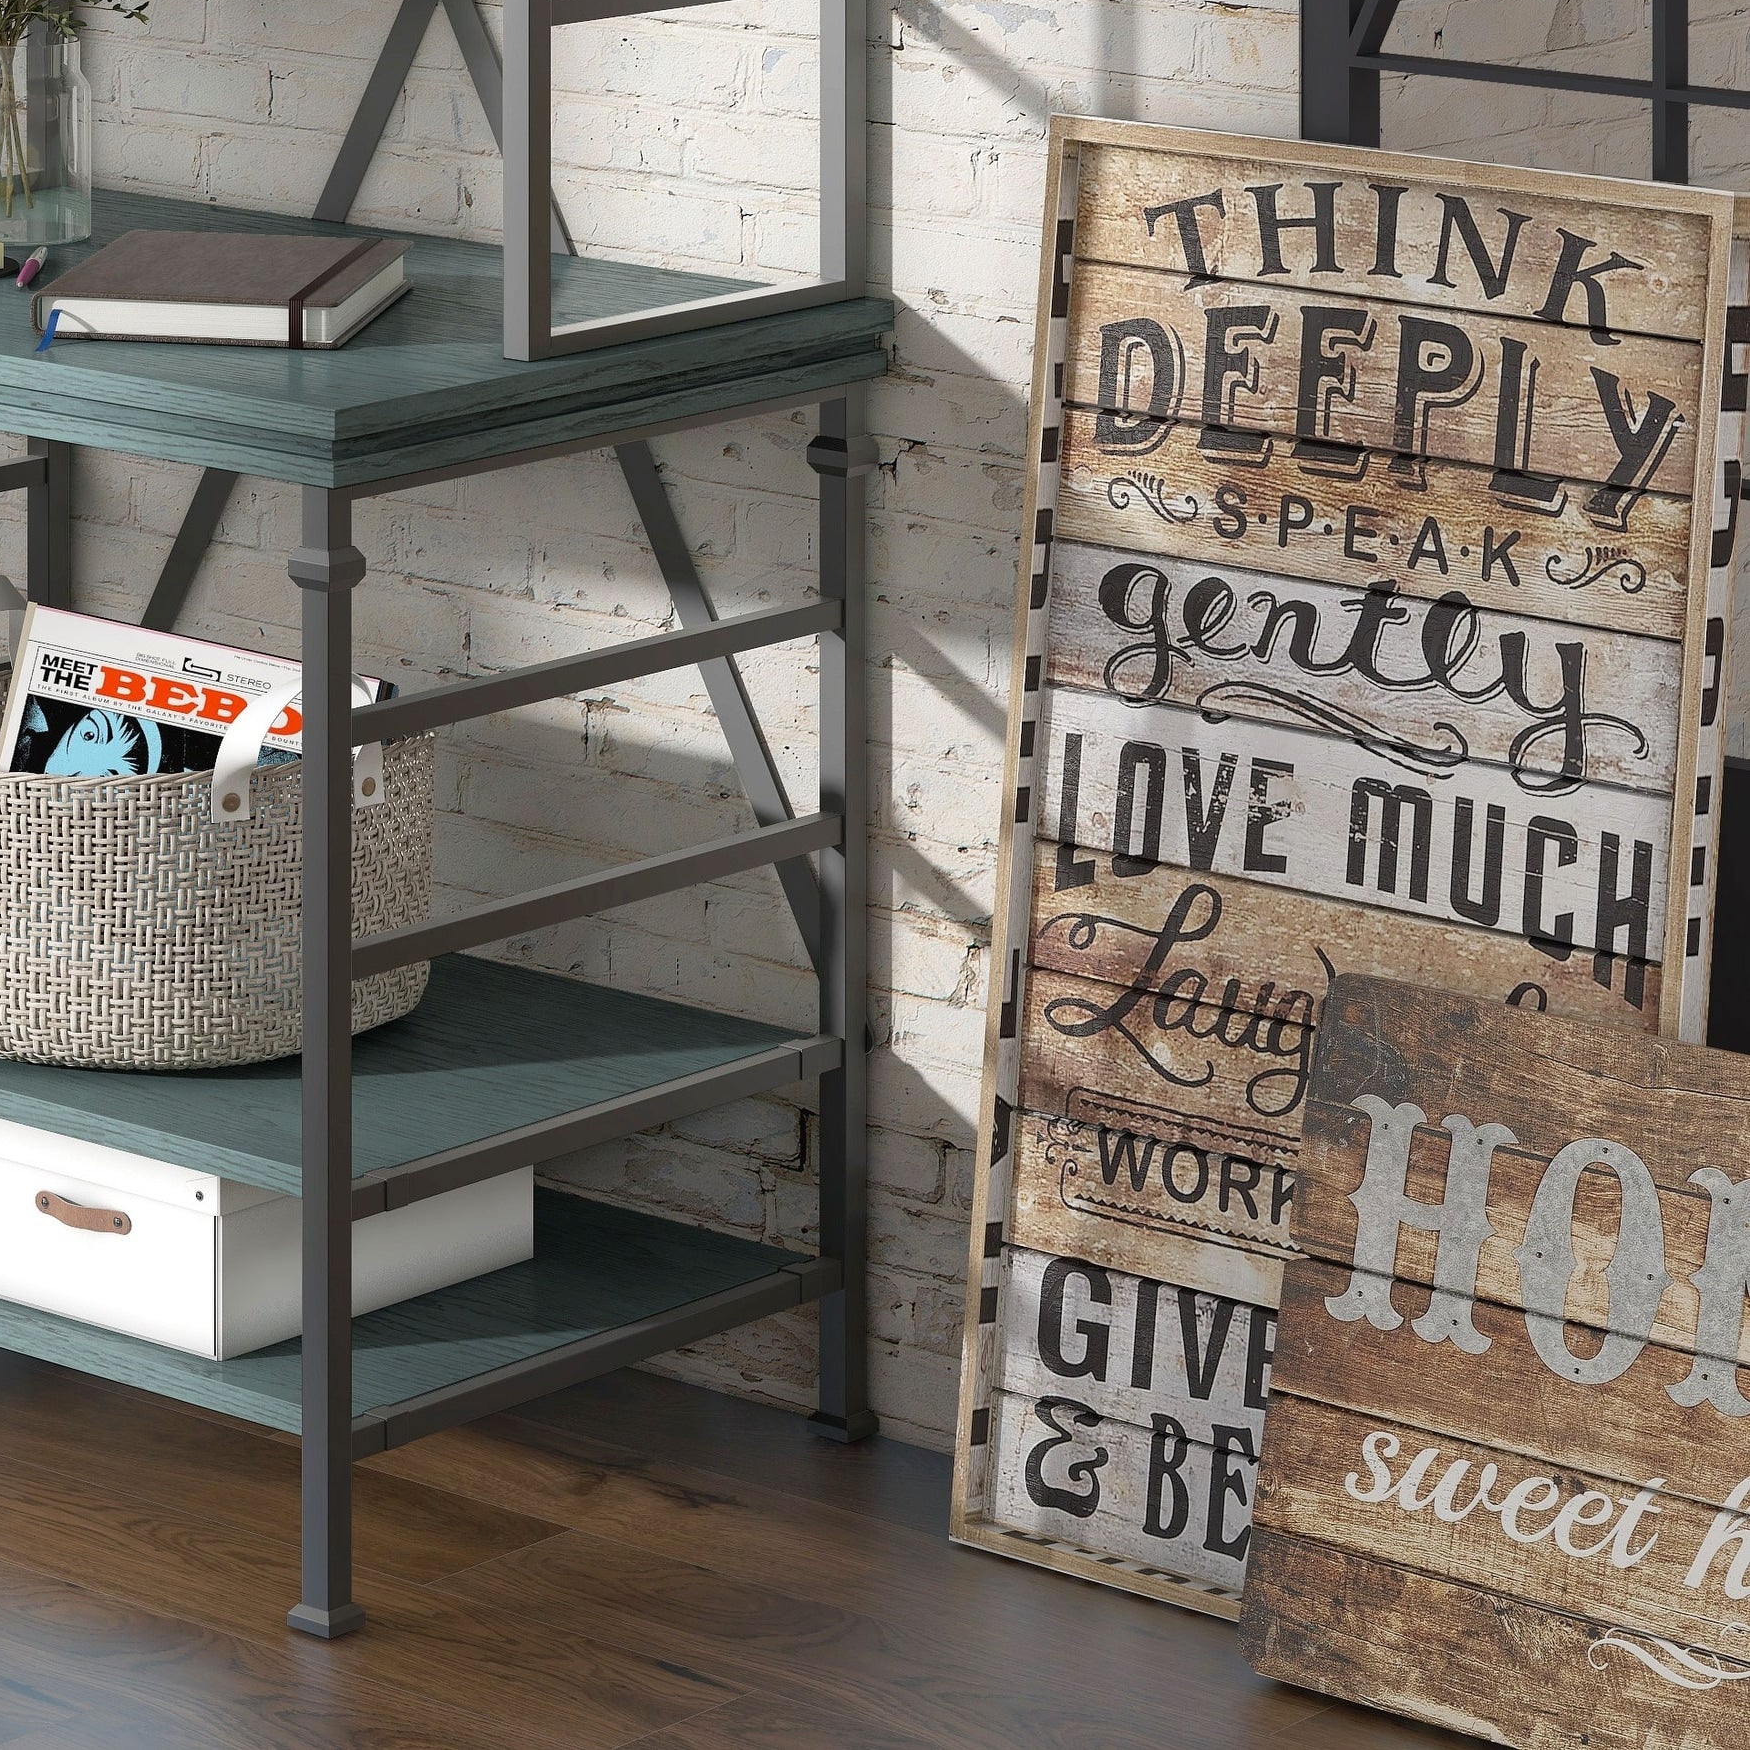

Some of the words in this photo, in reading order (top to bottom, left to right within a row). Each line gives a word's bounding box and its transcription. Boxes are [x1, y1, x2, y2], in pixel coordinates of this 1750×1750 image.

[1143, 179, 1645, 347] THINK
[1092, 303, 1686, 534] DEEPLY
[37, 683, 52, 692] THE
[55, 687, 78, 698] FIRST
[82, 693, 110, 704] ALBUM
[128, 703, 143, 712] THE
[146, 708, 186, 722] GALAXY'S
[271, 735, 302, 747] BOUNT
[40, 665, 92, 692] THE
[41, 653, 99, 676] MEET
[226, 673, 272, 690] STEREO
[1097, 561, 1649, 796] gently
[1054, 731, 1295, 893] LOVE
[1345, 776, 1654, 1012] MUCH
[1037, 883, 1336, 1117] Laug
[1024, 1394, 1109, 1519] &
[1141, 1412, 1260, 1562] BE
[1345, 1430, 1668, 1570] sweet
